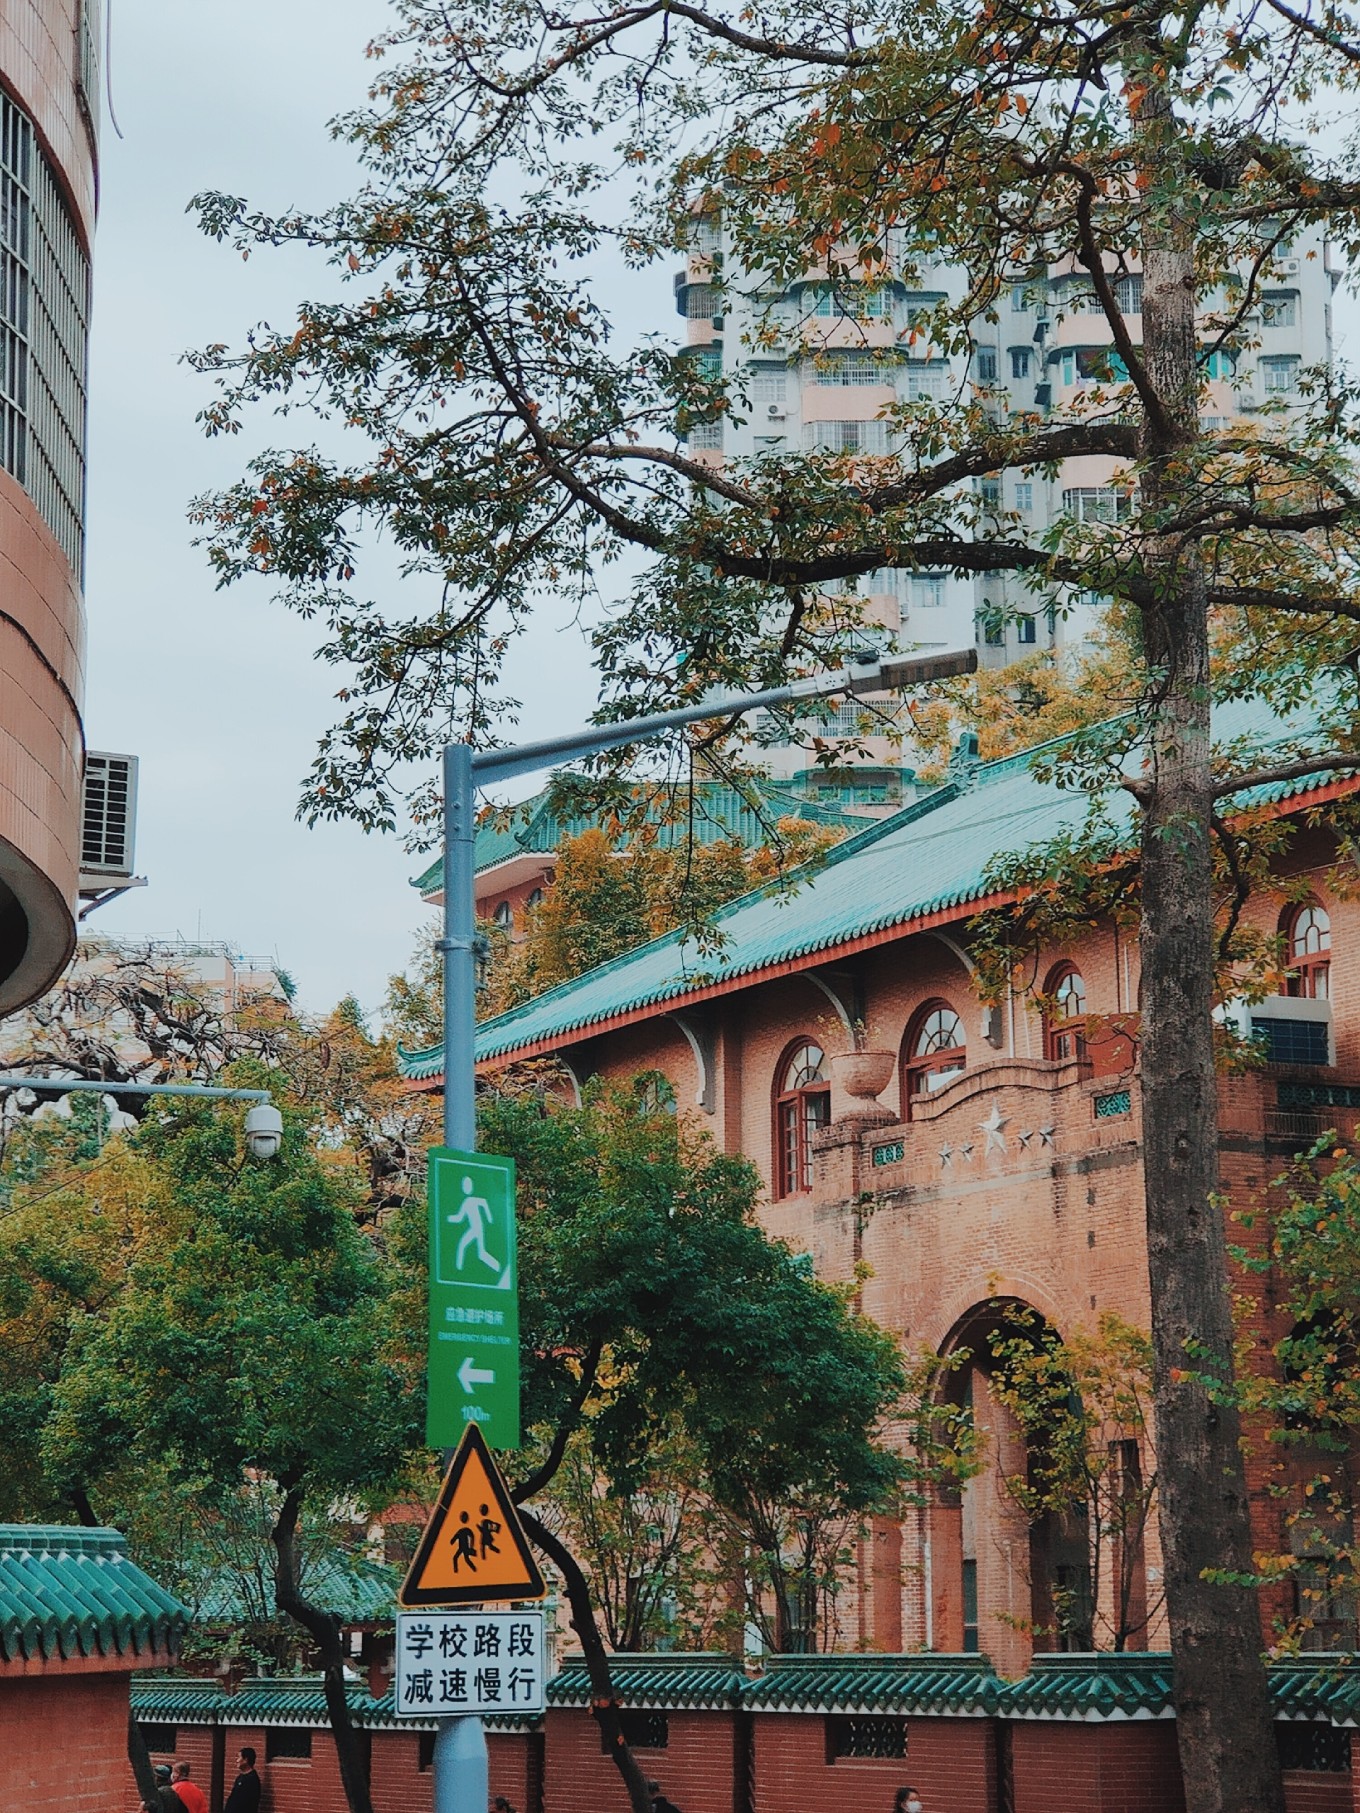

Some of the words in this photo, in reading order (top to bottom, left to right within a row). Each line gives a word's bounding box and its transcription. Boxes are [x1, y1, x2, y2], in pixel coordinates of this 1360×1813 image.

[461, 1406, 490, 1421] 100m
[405, 1622, 535, 1660] 学校路段
[404, 1666, 536, 1705] 减速慢行
